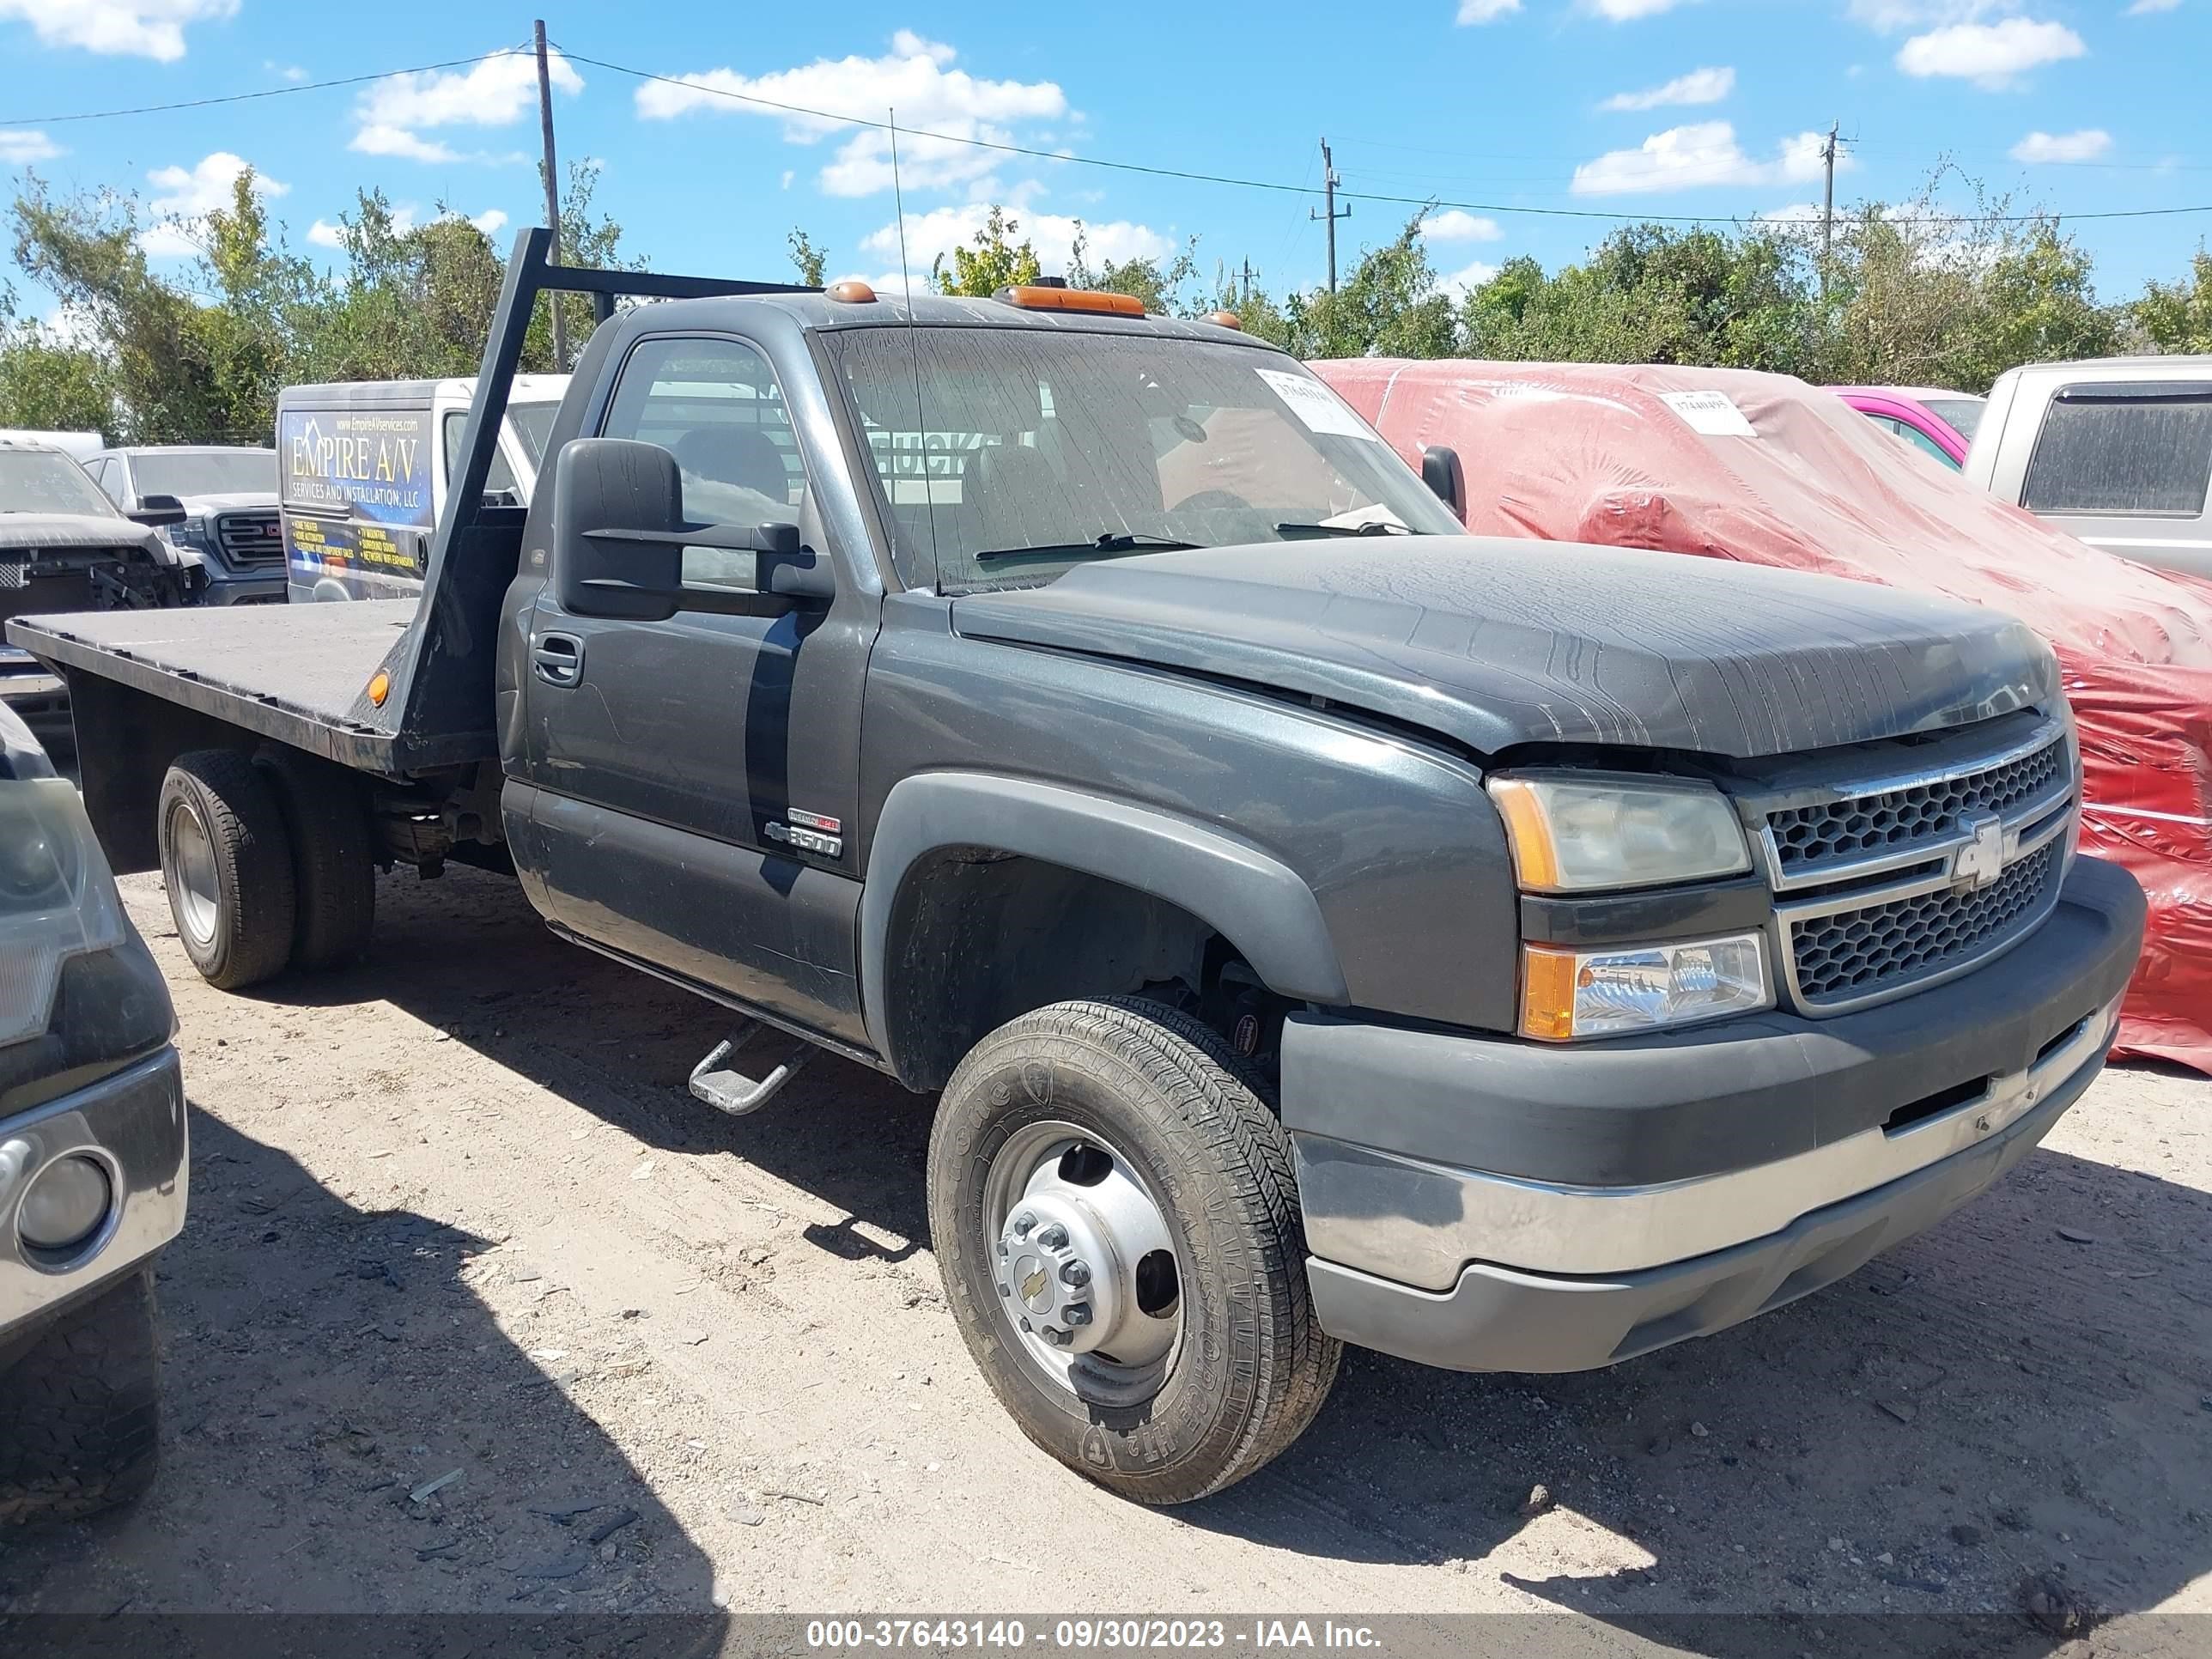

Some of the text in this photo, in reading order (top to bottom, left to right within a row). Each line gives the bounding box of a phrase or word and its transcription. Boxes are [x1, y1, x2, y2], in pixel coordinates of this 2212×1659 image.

[292, 435, 418, 484] EMPIRE A/V
[293, 482, 325, 499] SERVICES
[326, 483, 342, 501] AND
[404, 490, 419, 509] LLC
[789, 826, 842, 857] 3500
